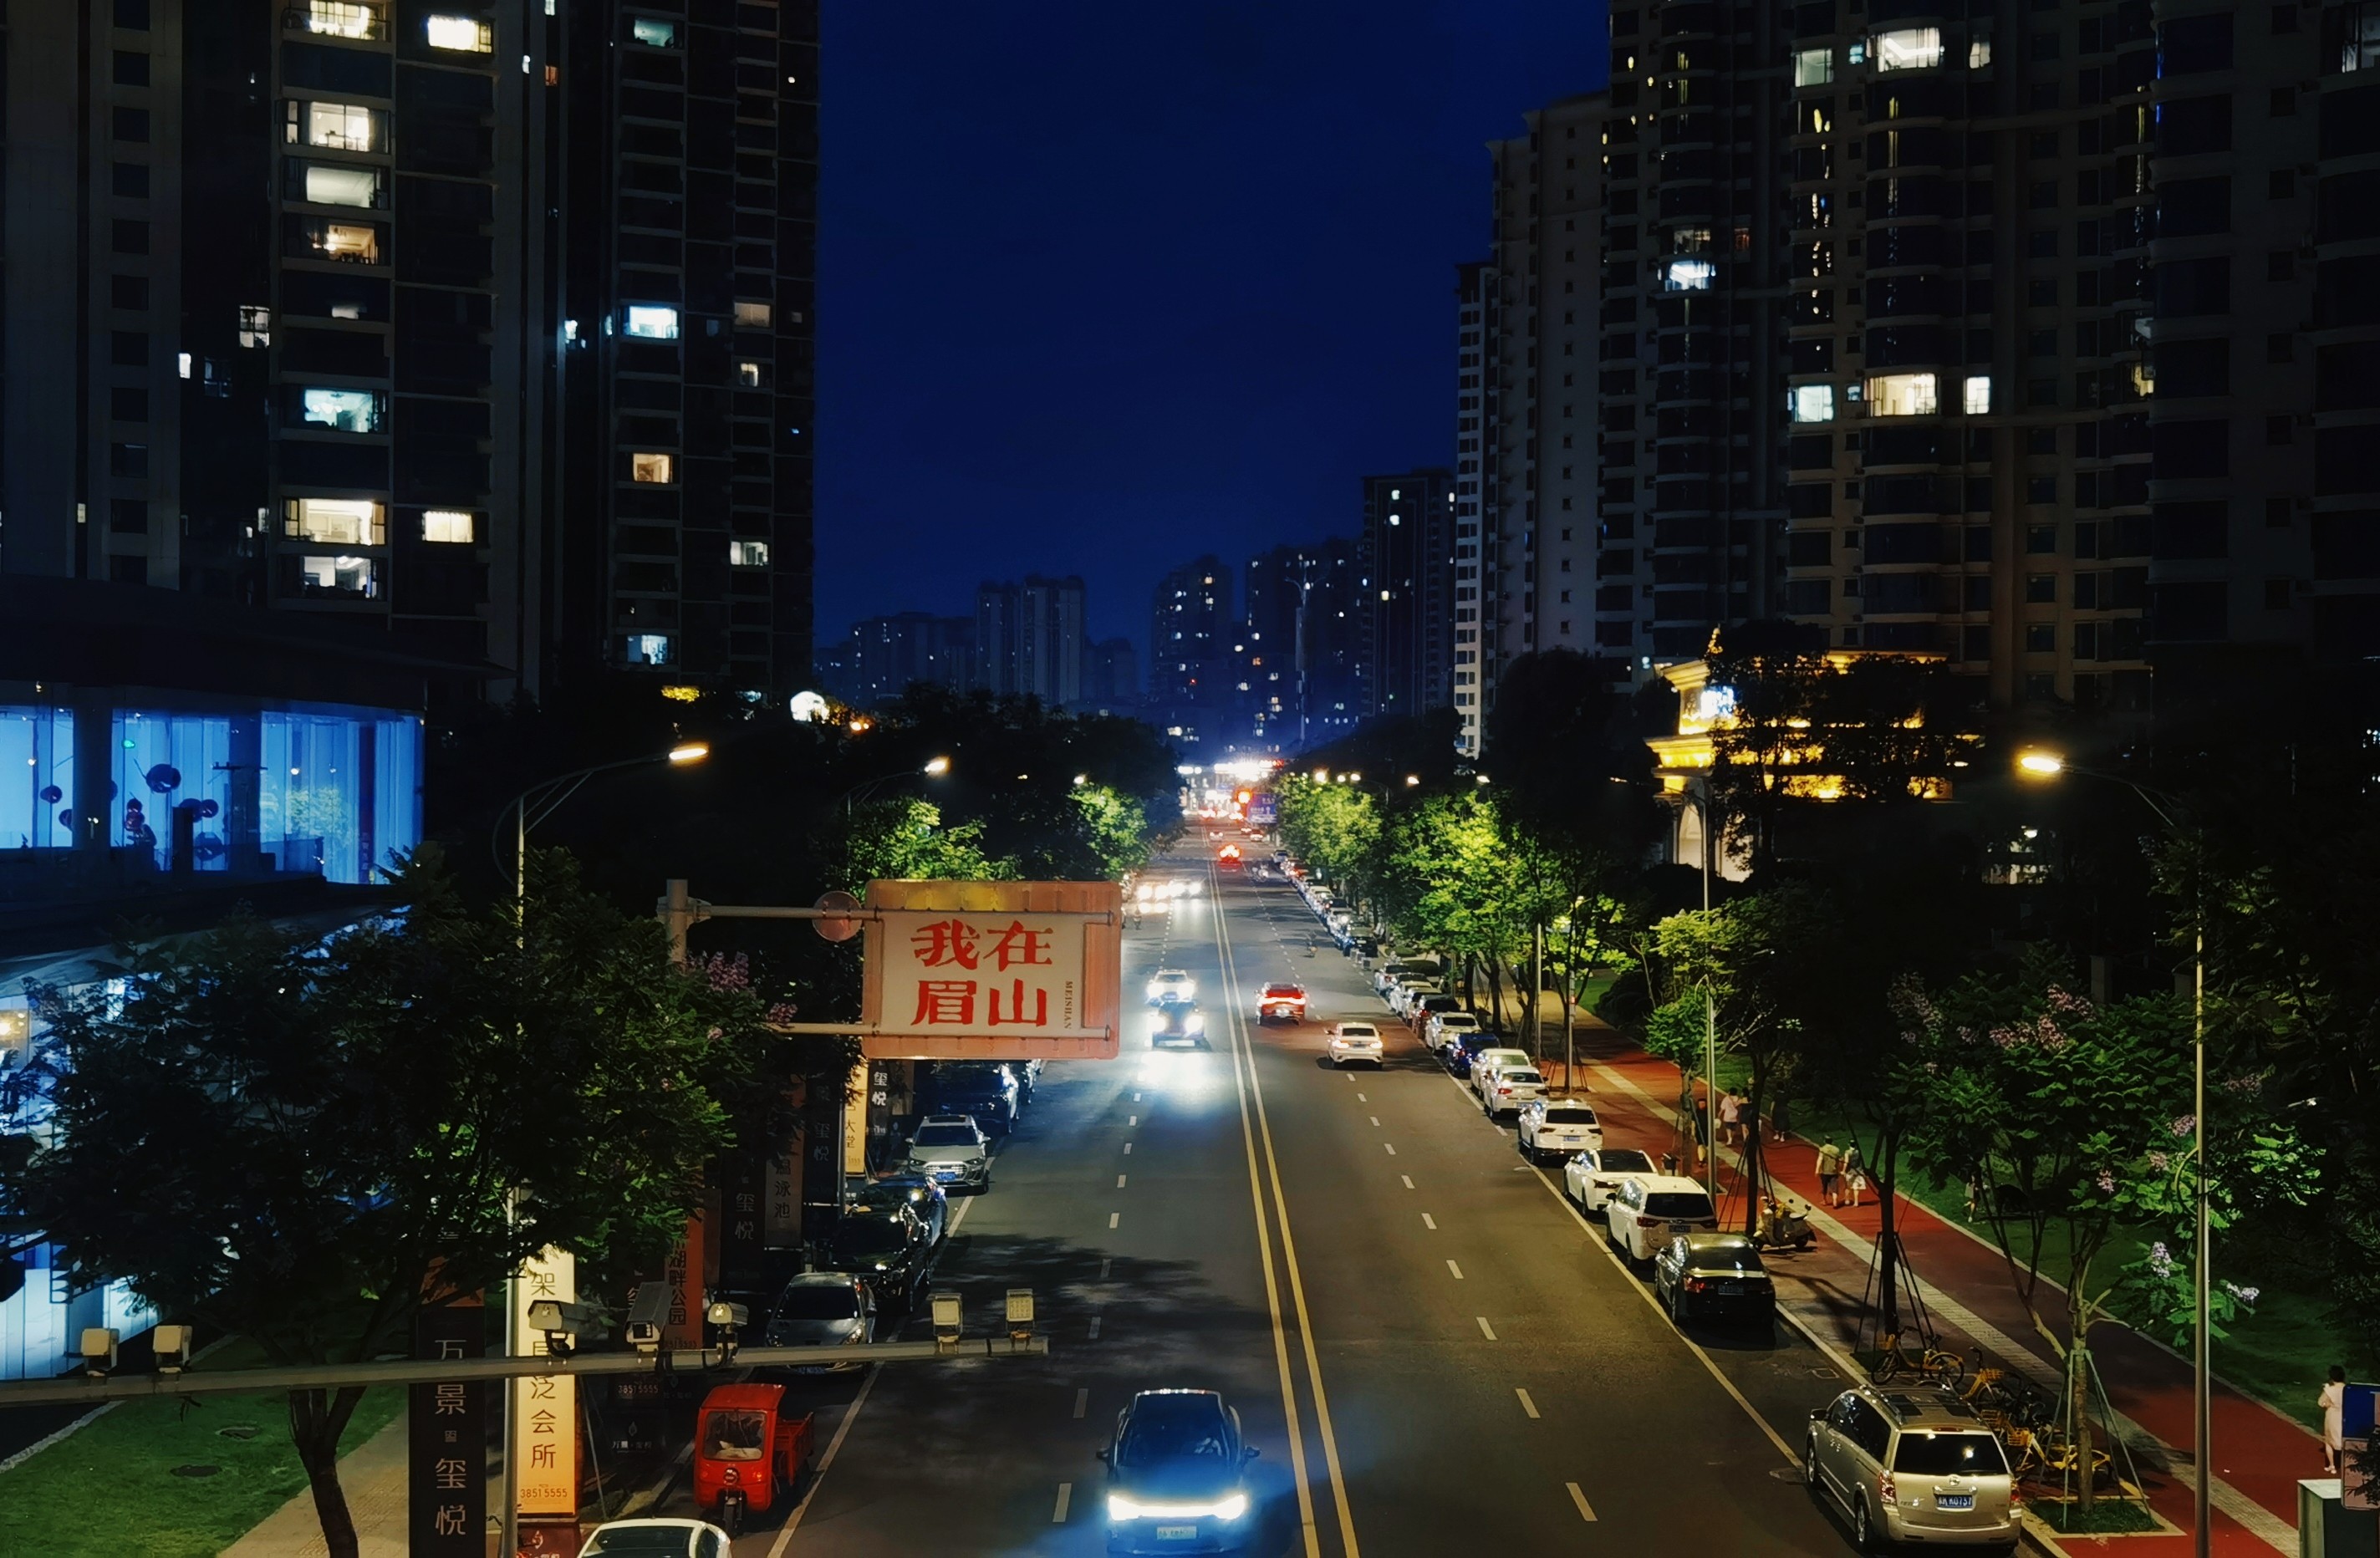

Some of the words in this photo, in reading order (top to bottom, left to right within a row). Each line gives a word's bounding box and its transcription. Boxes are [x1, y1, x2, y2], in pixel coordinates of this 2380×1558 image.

[910, 919, 1053, 972] 我在
[910, 978, 1047, 1027] 眉山
[1064, 980, 1073, 1029] MEISHAN
